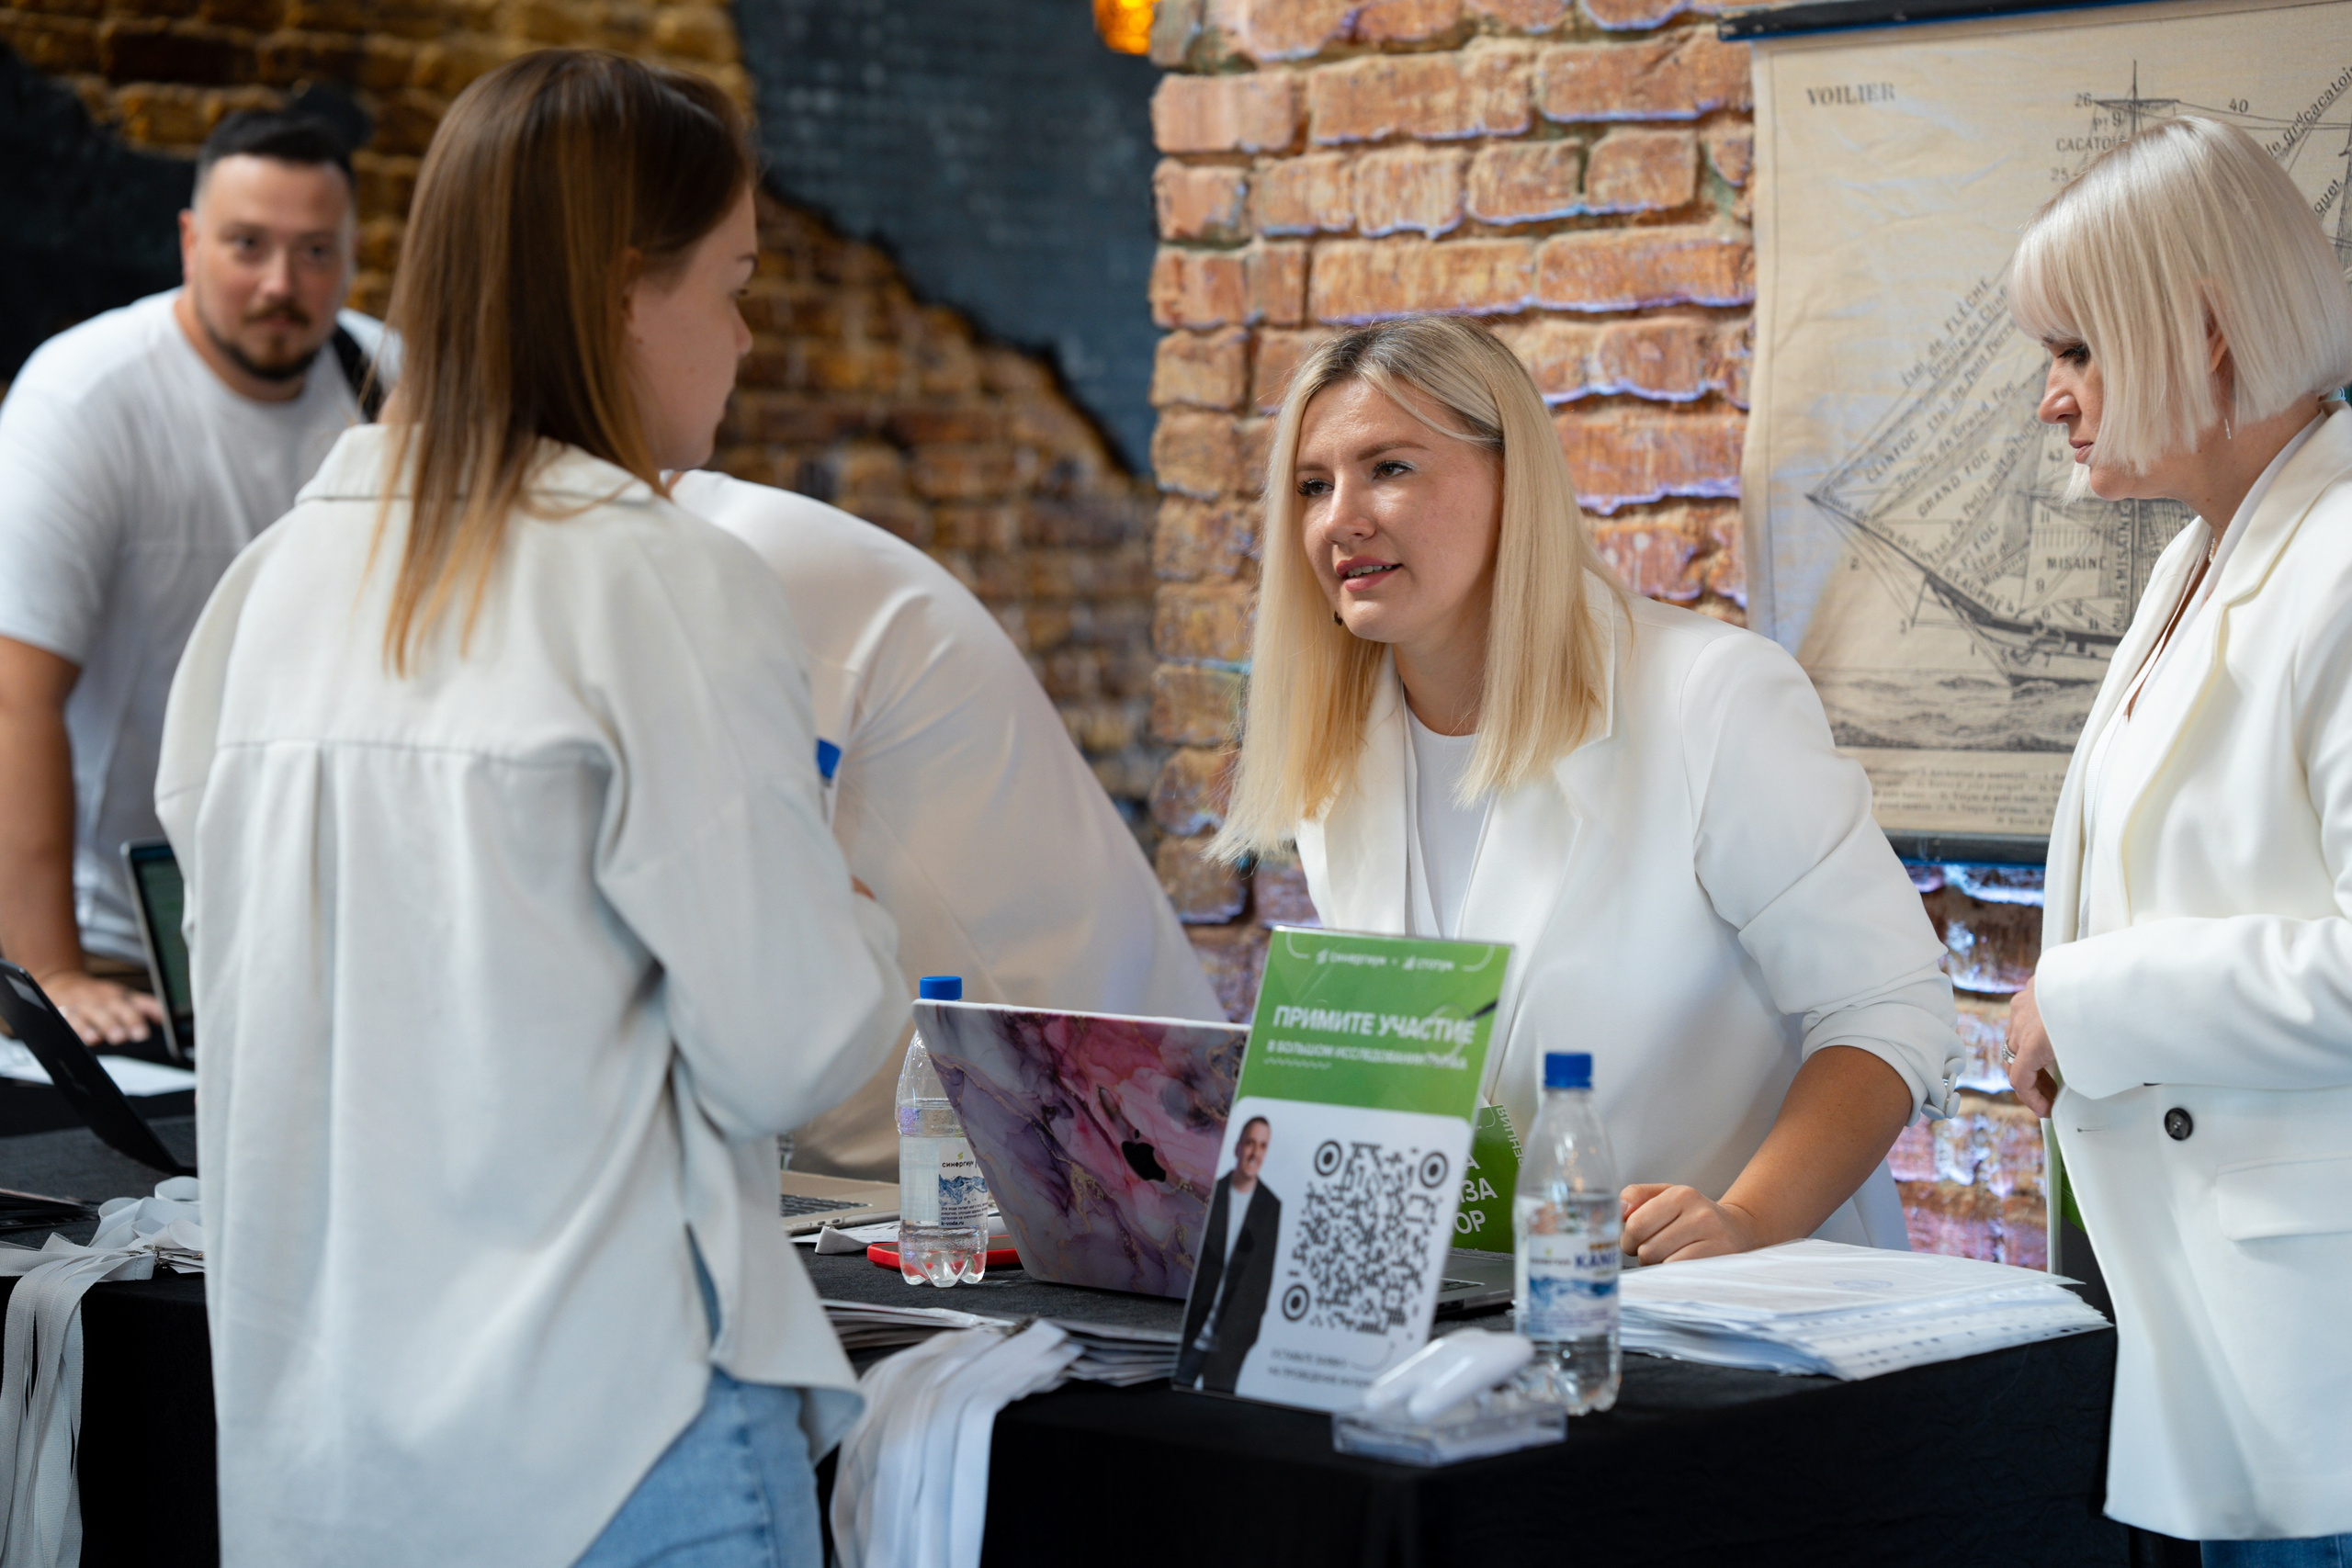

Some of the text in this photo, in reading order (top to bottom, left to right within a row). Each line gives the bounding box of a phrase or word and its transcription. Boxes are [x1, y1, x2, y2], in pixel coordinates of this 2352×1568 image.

[1806, 82, 1894, 107] VOILIER
[2075, 93, 2094, 108] 26
[2229, 98, 2249, 114] 40
[1944, 279, 1991, 336] FLÈCHE
[1951, 400, 1990, 438] Grand
[1865, 427, 1919, 484] CLINFOC
[1917, 449, 1991, 518] GRAND FOC
[1962, 483, 1987, 515] Petit
[1974, 520, 2000, 552] FOC
[2046, 556, 2108, 571] MISAINE
[1944, 566, 2004, 612] BEAUPRÉ
[1273, 1005, 1476, 1045] ПРИМИТЕ УЧАСТИЕ
[1266, 1039, 1276, 1053] В
[1277, 1041, 1333, 1058] БОЛЬШОМ
